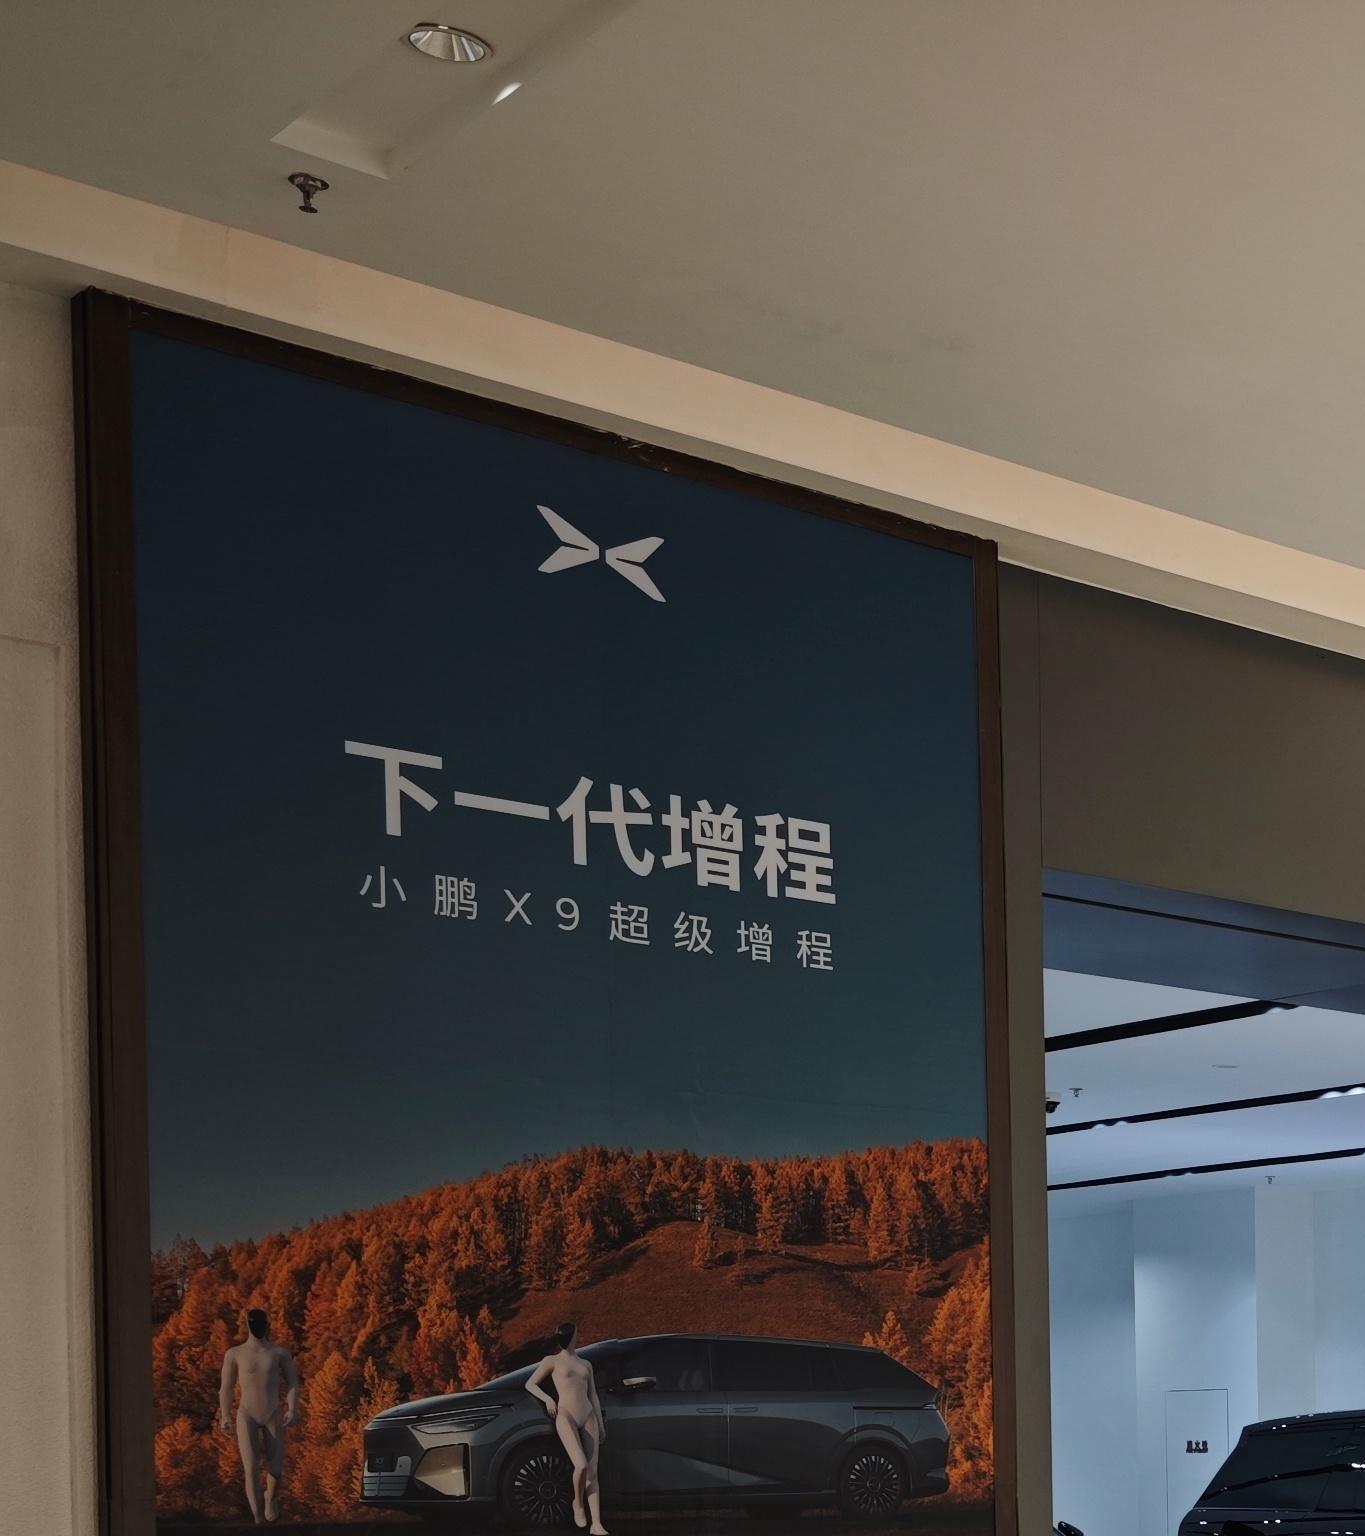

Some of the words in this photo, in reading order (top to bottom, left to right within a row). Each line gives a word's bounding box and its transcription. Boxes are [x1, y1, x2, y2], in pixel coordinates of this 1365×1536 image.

[344, 739, 837, 905] 下一代增程
[359, 864, 835, 972] 小鹏X9超级增程
